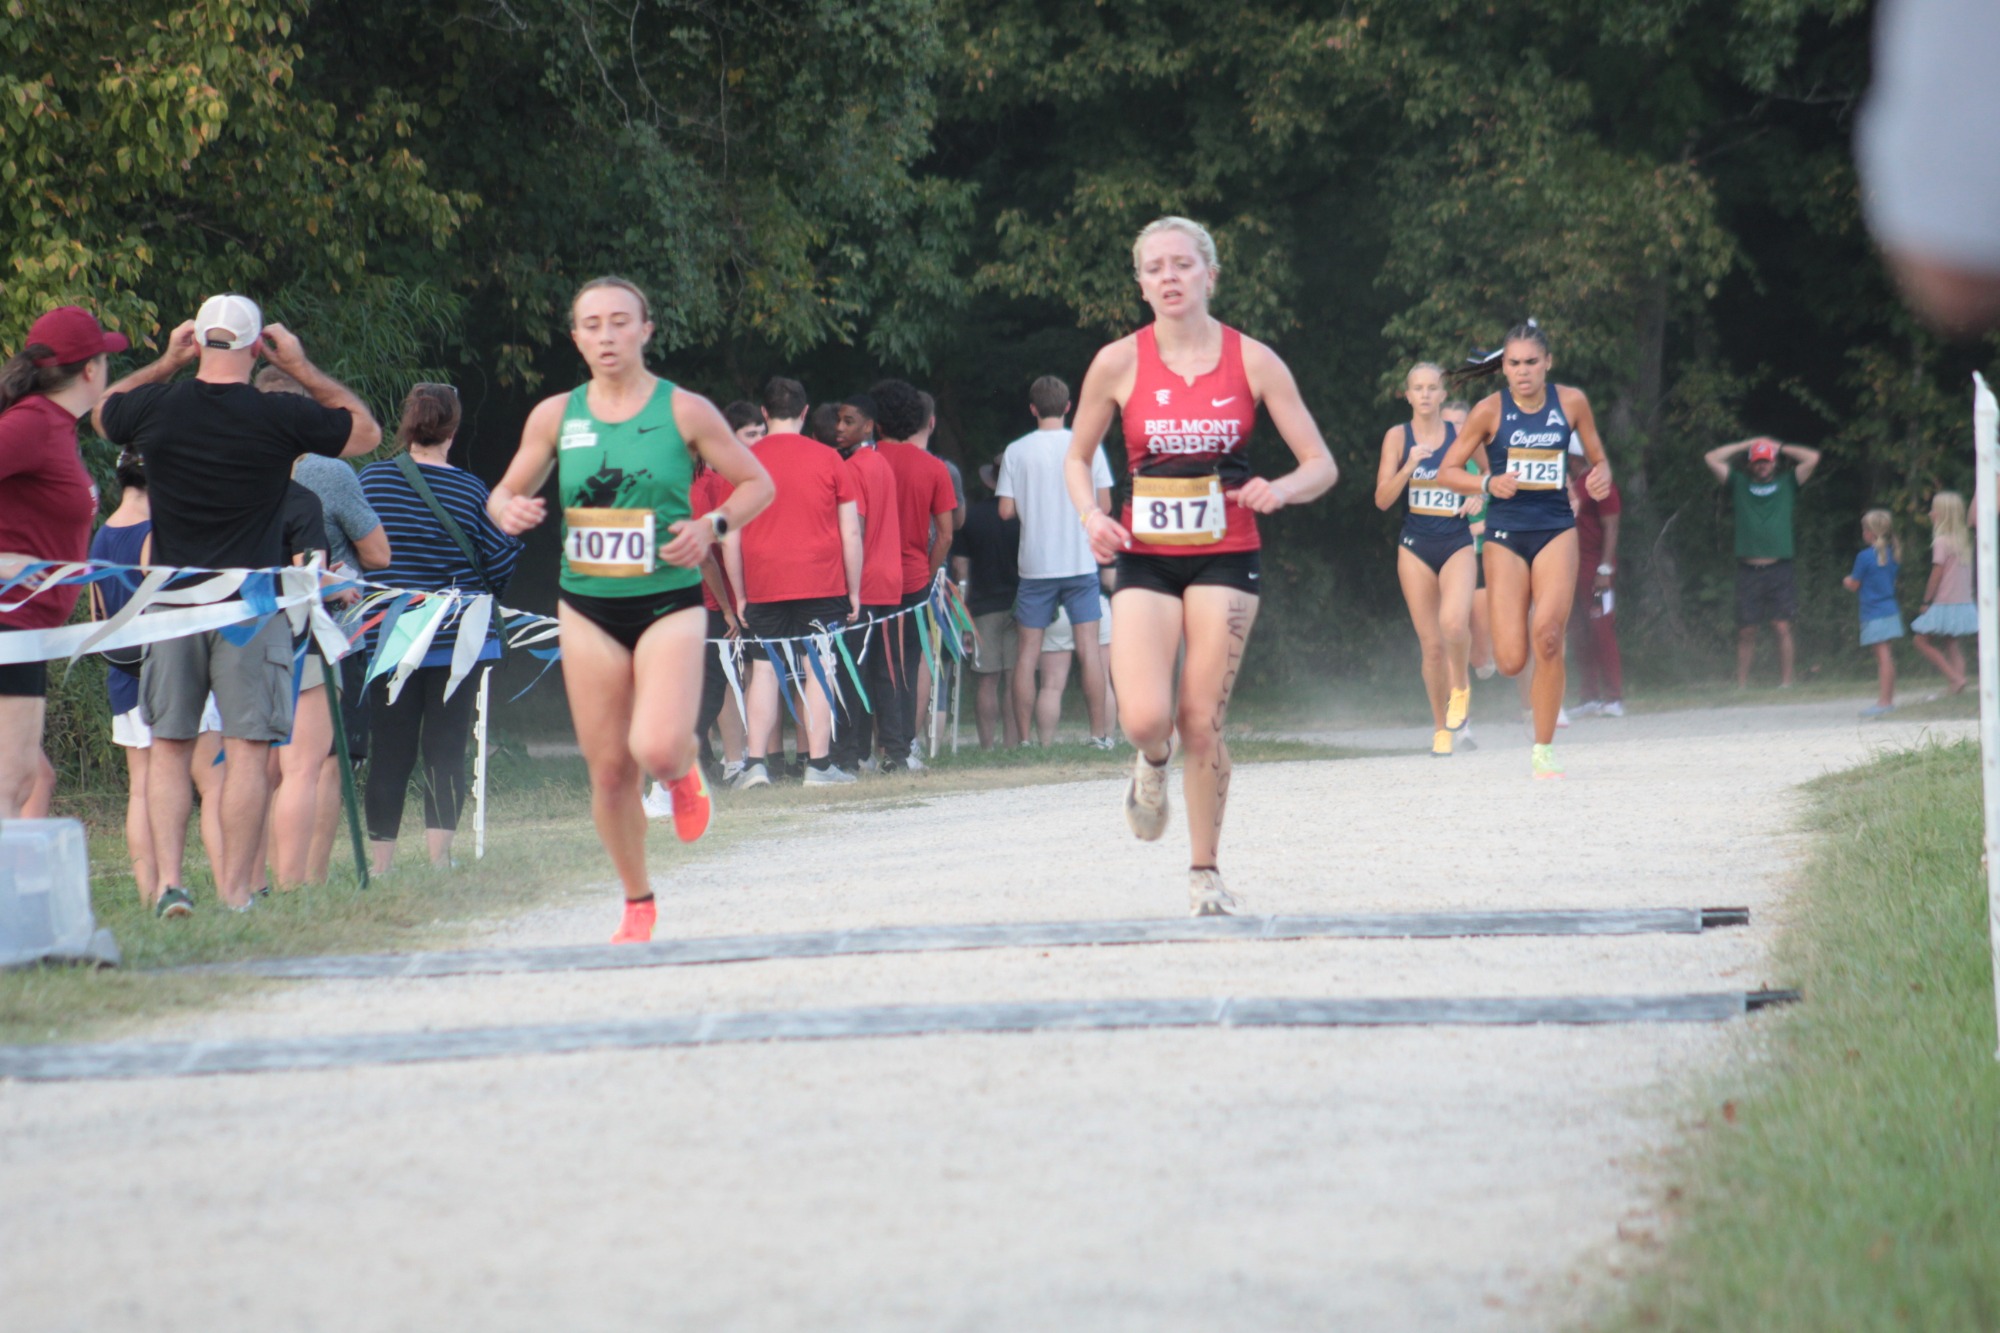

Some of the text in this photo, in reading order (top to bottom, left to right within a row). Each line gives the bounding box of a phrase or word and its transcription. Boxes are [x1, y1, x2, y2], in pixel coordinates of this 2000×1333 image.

[1144, 419, 1241, 435] BELMONT
[1147, 434, 1241, 455] ABBEY
[1509, 429, 1562, 449] Ospreys
[1512, 461, 1558, 481] 1125
[1411, 490, 1455, 508] 1129
[1149, 500, 1209, 530] 817
[575, 530, 645, 560] 1070
[1226, 599, 1248, 642] ME
